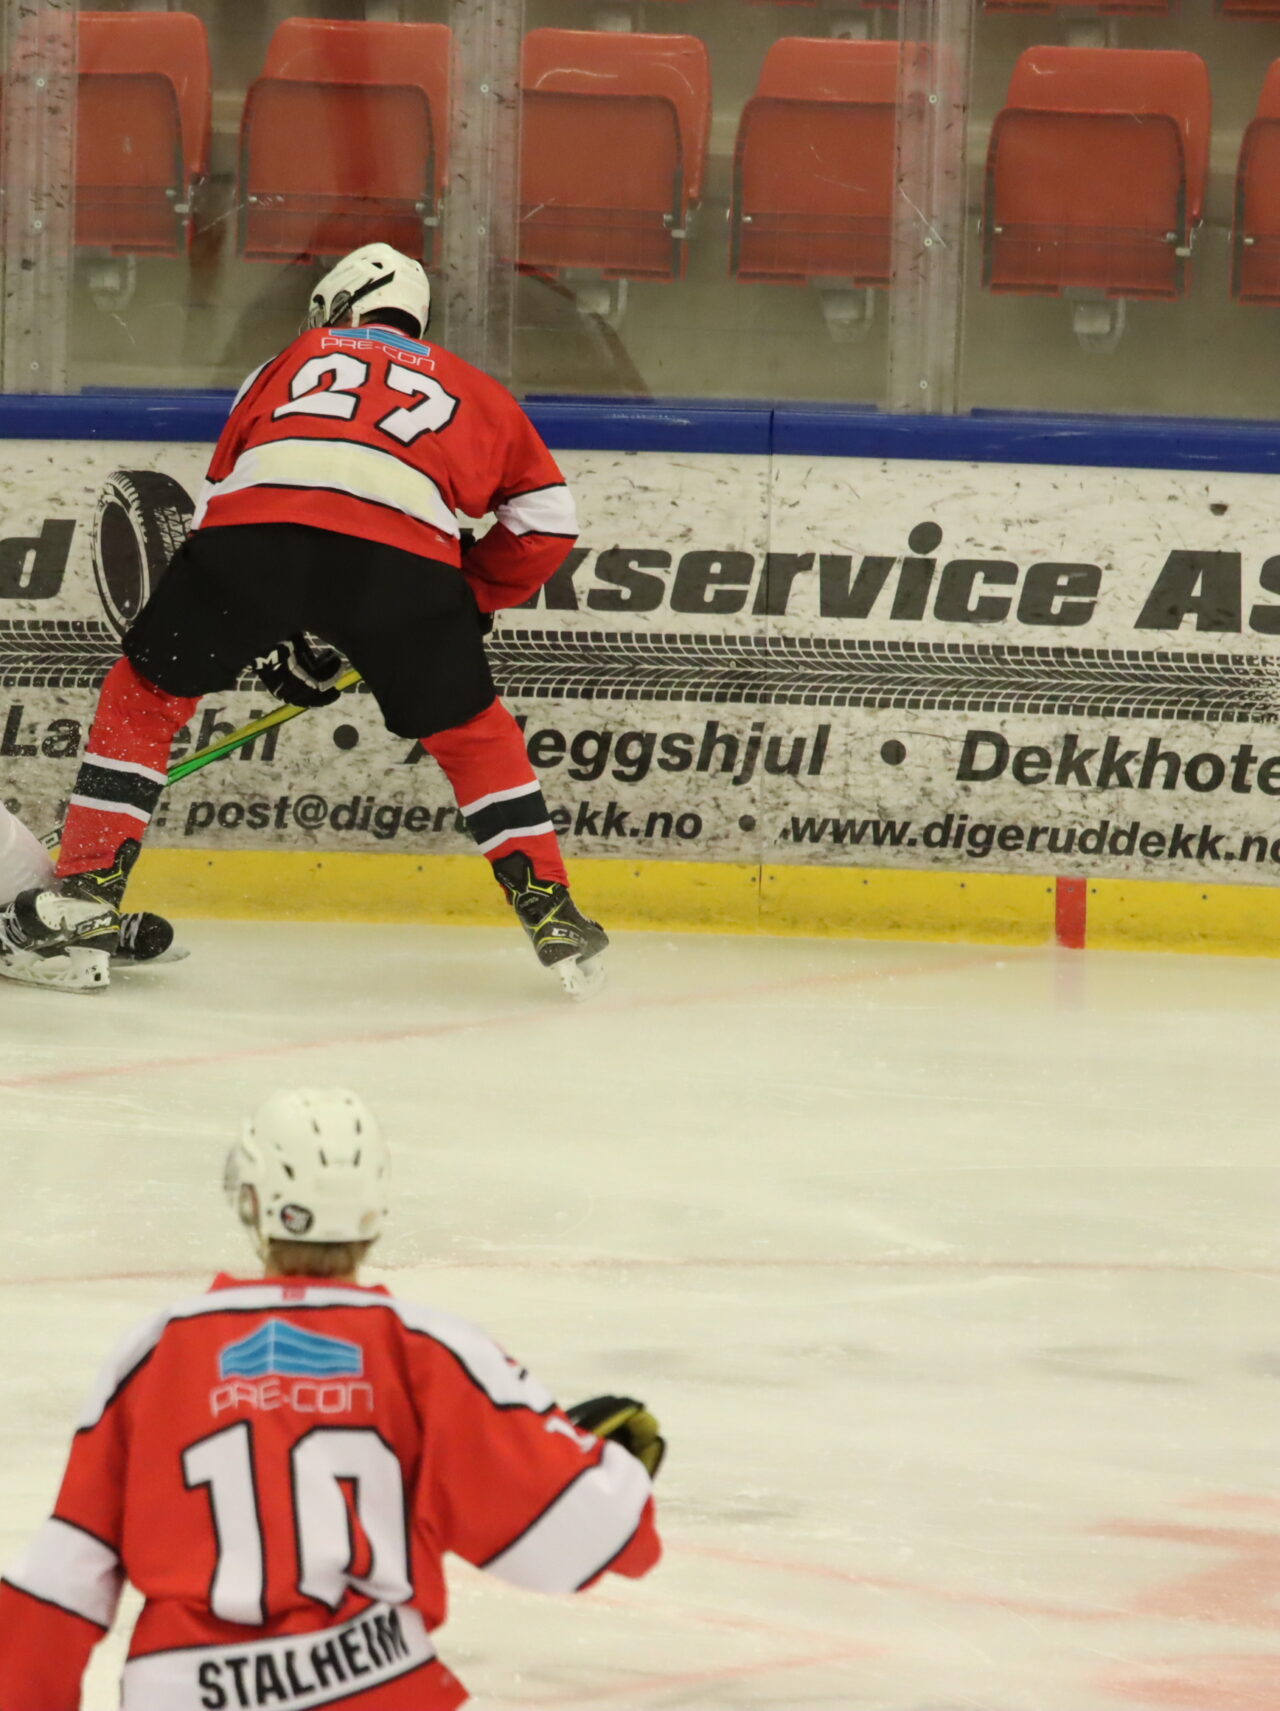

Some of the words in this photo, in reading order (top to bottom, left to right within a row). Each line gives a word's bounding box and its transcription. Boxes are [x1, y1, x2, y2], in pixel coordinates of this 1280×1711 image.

[272, 351, 460, 447] 27
[403, 715, 832, 786] eggshjul
[180, 1417, 416, 1627] 10
[198, 1606, 411, 1711] STALHEIM
